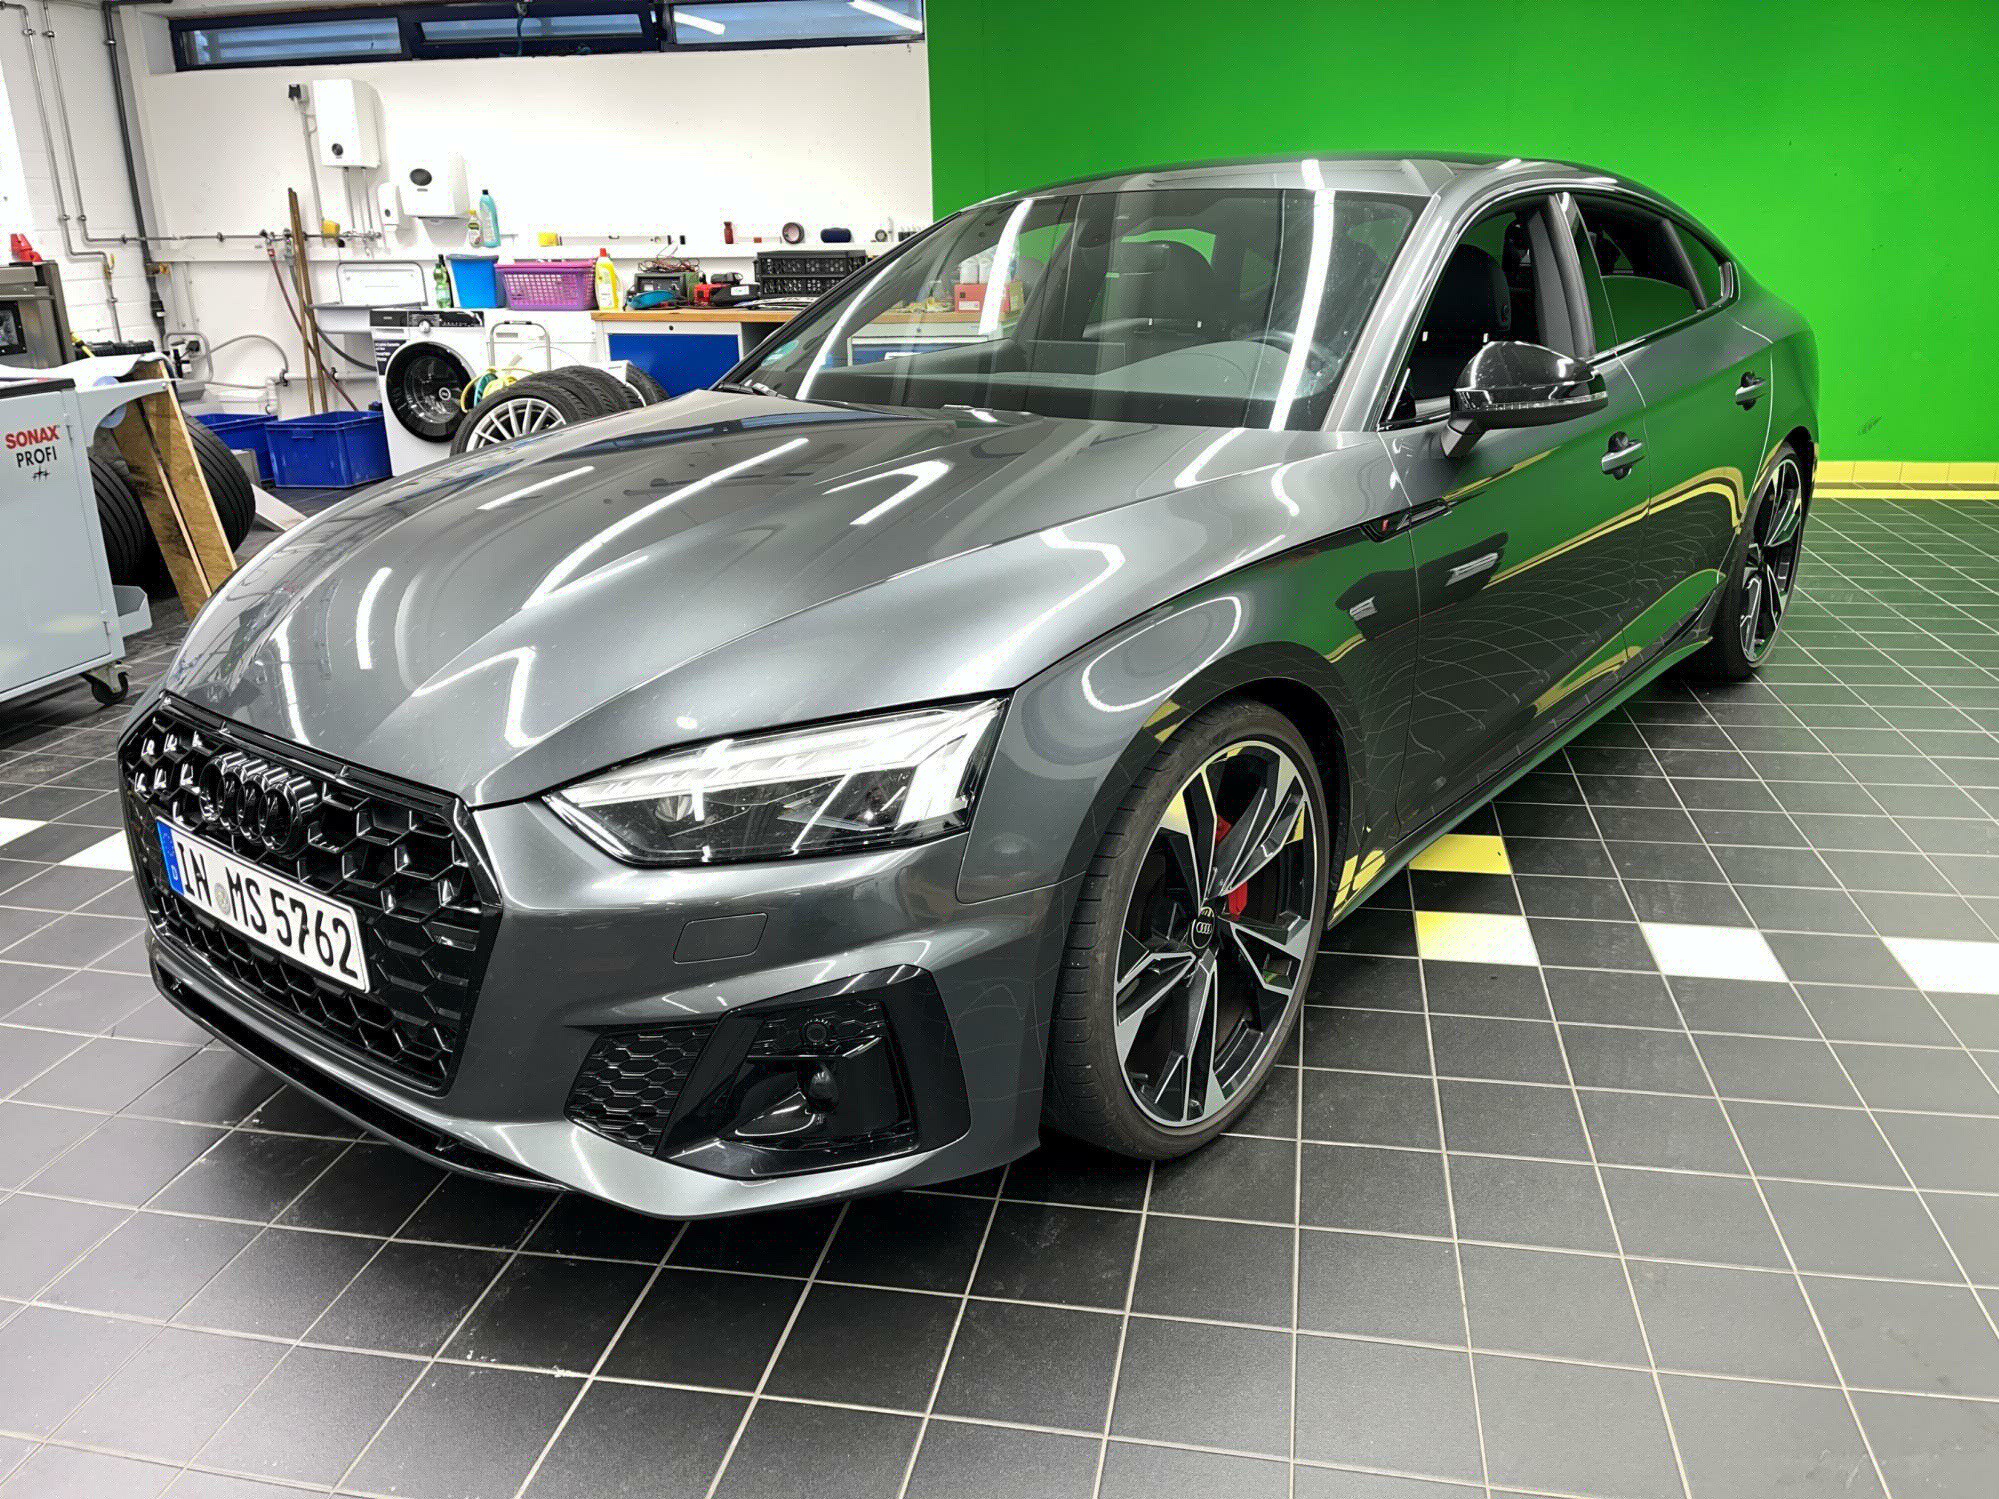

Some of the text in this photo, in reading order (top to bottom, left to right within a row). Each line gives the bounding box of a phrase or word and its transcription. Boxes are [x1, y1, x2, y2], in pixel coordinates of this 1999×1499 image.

[5, 425, 59, 449] SONAX
[16, 446, 57, 468] PROFI
[177, 841, 359, 981] IN MS 5762
